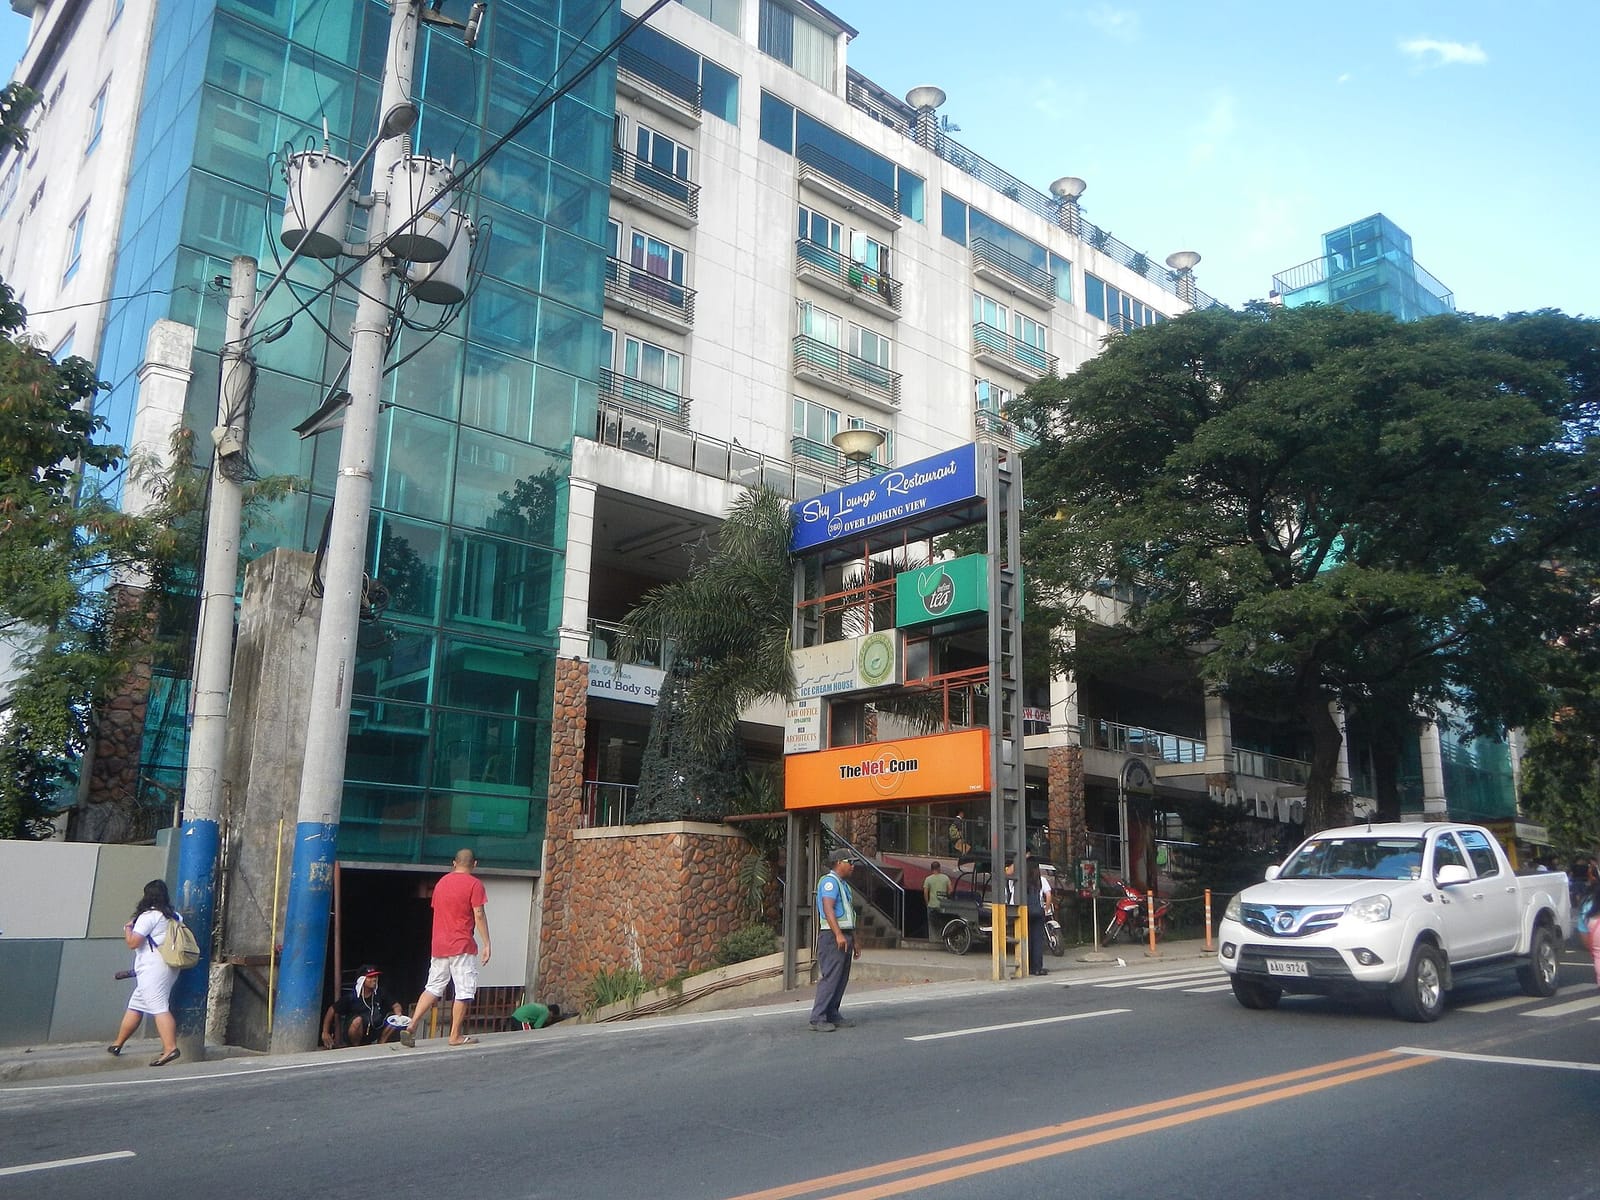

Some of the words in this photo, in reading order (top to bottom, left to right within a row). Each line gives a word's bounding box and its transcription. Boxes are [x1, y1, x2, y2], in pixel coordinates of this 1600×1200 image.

[802, 499, 830, 523] Sky
[834, 491, 877, 517] Lounge
[880, 460, 957, 497] Restaurant
[844, 517, 865, 532] OVER
[867, 506, 903, 526] LOOKING
[905, 498, 927, 514] VIEW
[930, 590, 951, 609] tea
[590, 679, 611, 689] and
[614, 680, 641, 696] Body
[800, 687, 811, 697] ICE
[812, 683, 833, 695] CREAM
[833, 680, 853, 692] HOUSE
[800, 707, 818, 717] OFFICE
[1035, 711, 1050, 721] OPE
[785, 733, 817, 744] ARCHITECTS
[839, 759, 918, 779] TheNet.Com
[1285, 962, 1305, 973] 9724
